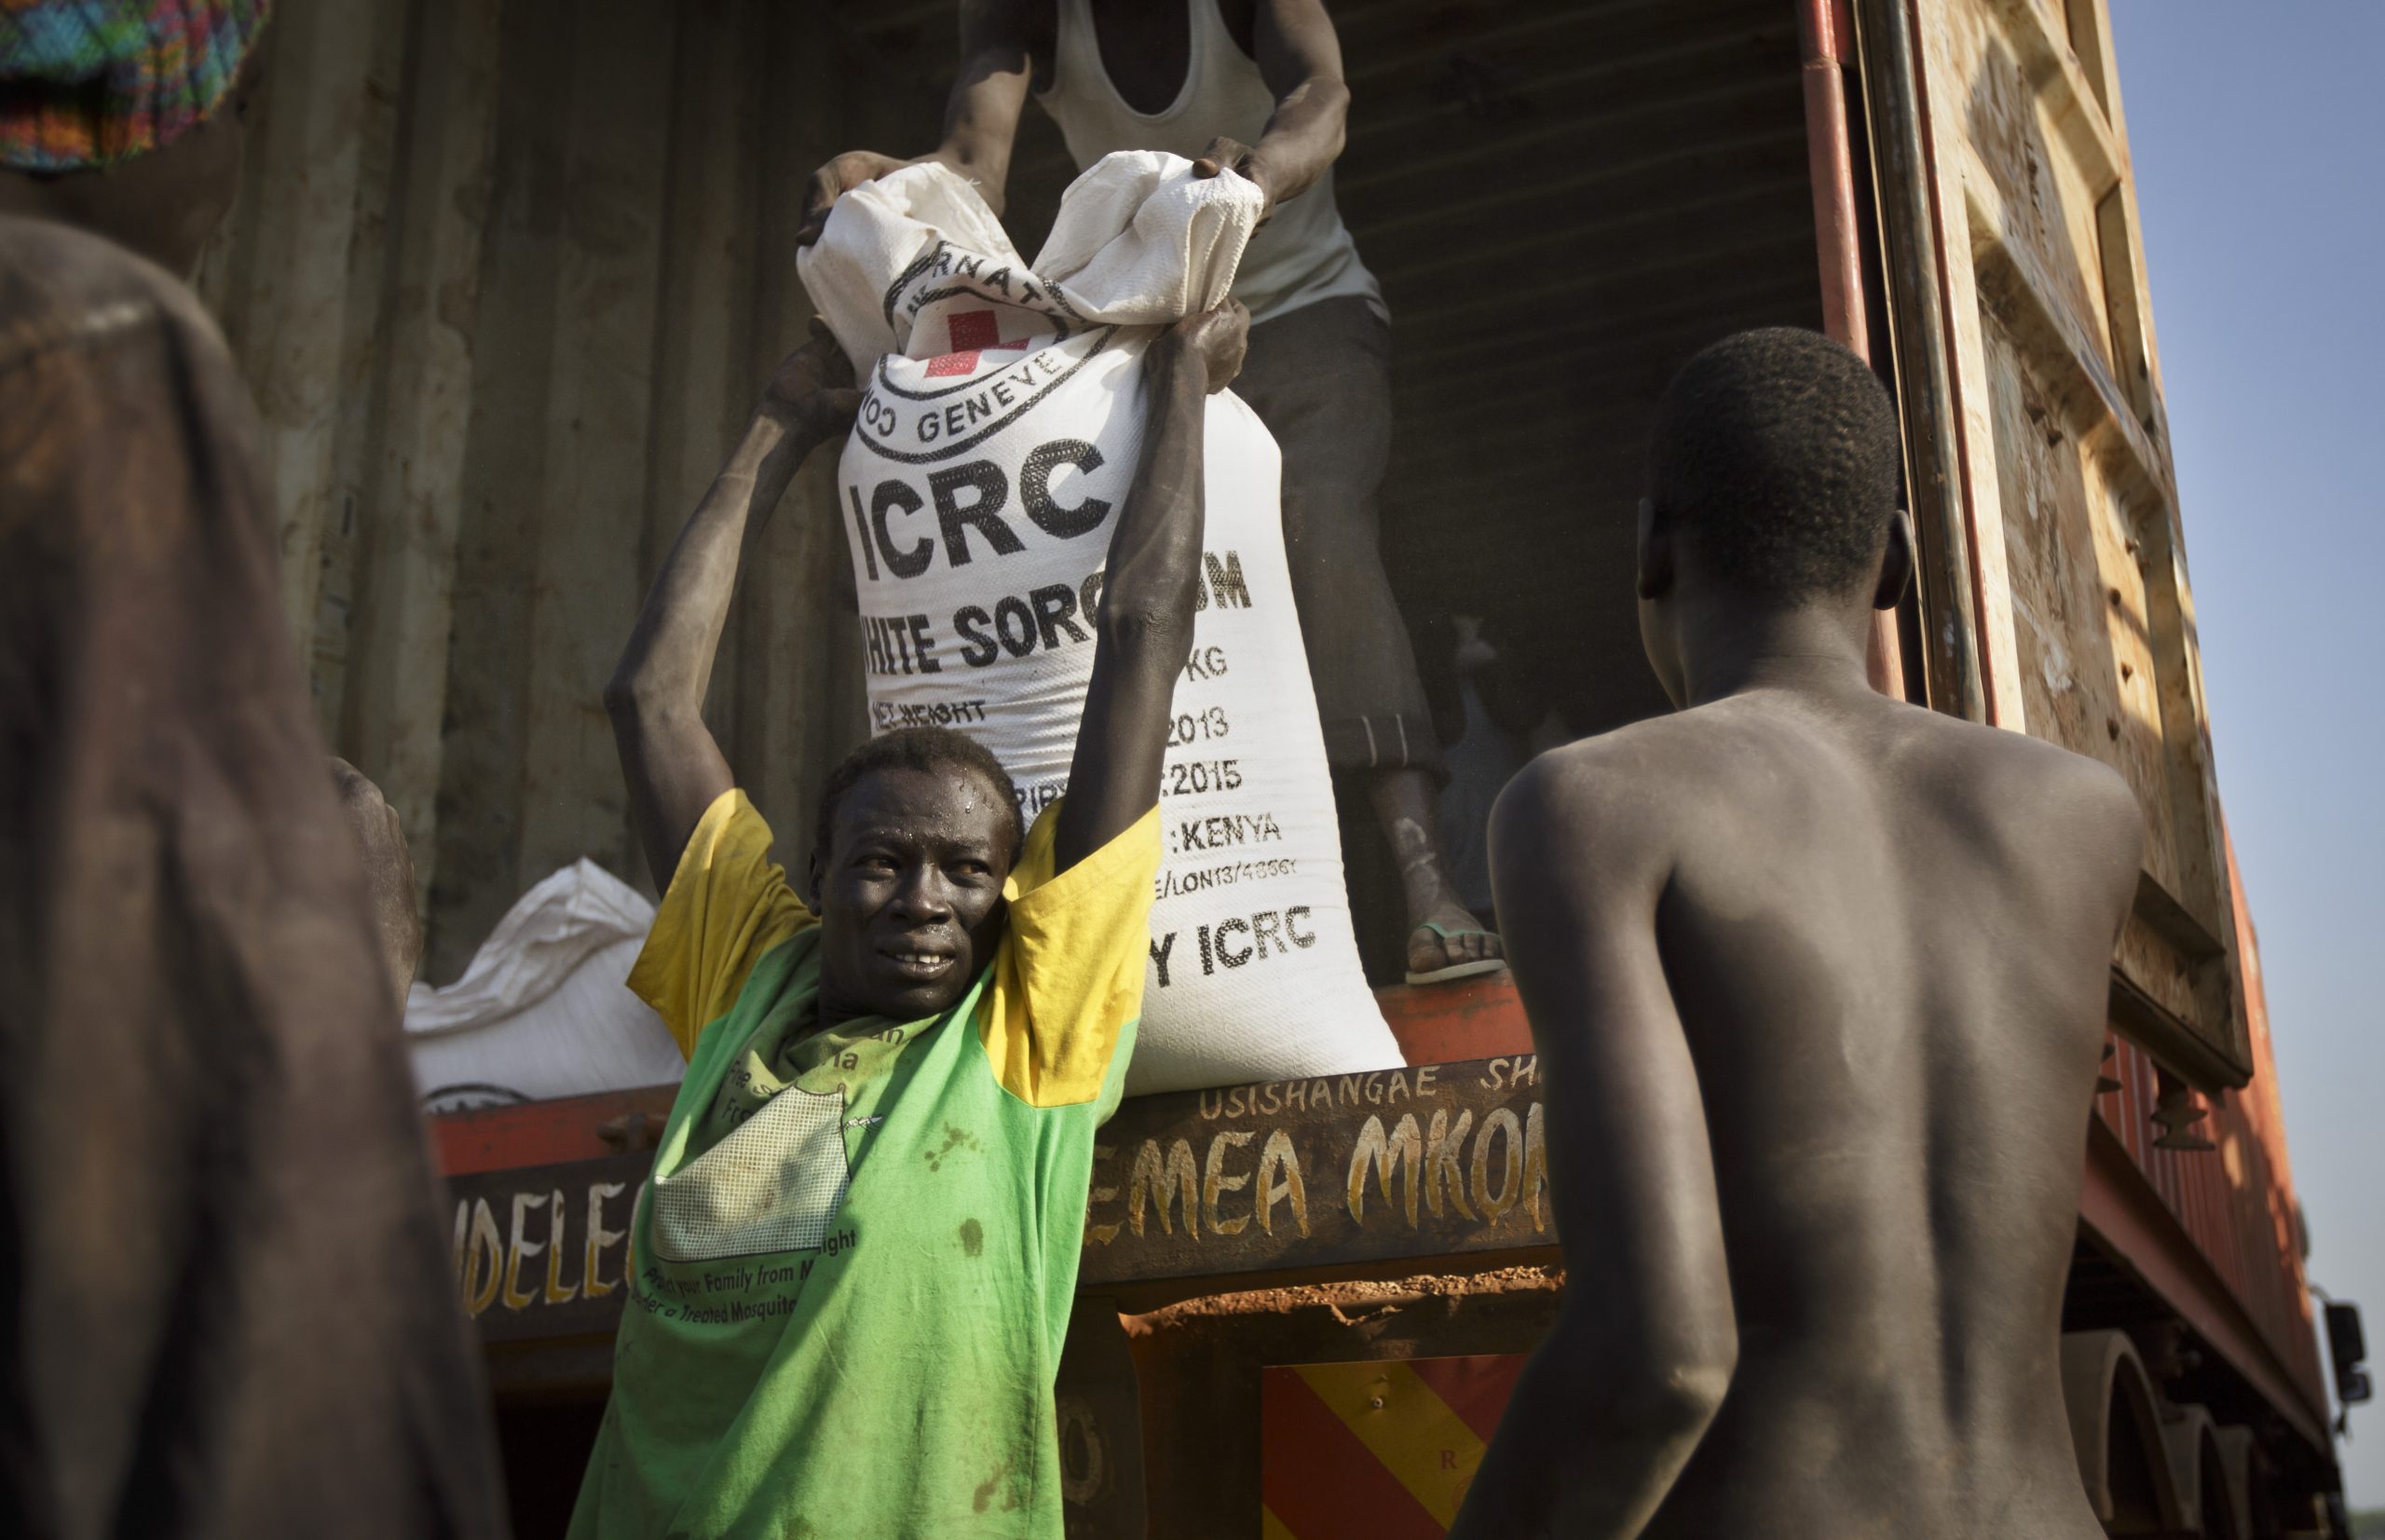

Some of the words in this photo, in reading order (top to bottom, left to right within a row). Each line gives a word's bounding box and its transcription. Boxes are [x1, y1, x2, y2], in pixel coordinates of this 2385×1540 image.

[917, 351, 1062, 443] GENEVE
[849, 438, 1112, 582] ICRC
[862, 613, 943, 675] HITE
[1196, 906, 1316, 975] ICRC
[1199, 1065, 1441, 1121] USISHANGAE
[1479, 1055, 1543, 1091] SH
[1084, 1127, 1312, 1246] EMEA
[703, 1266, 753, 1293] Family
[756, 1264, 794, 1286] from
[1439, 1449, 1458, 1470] R
